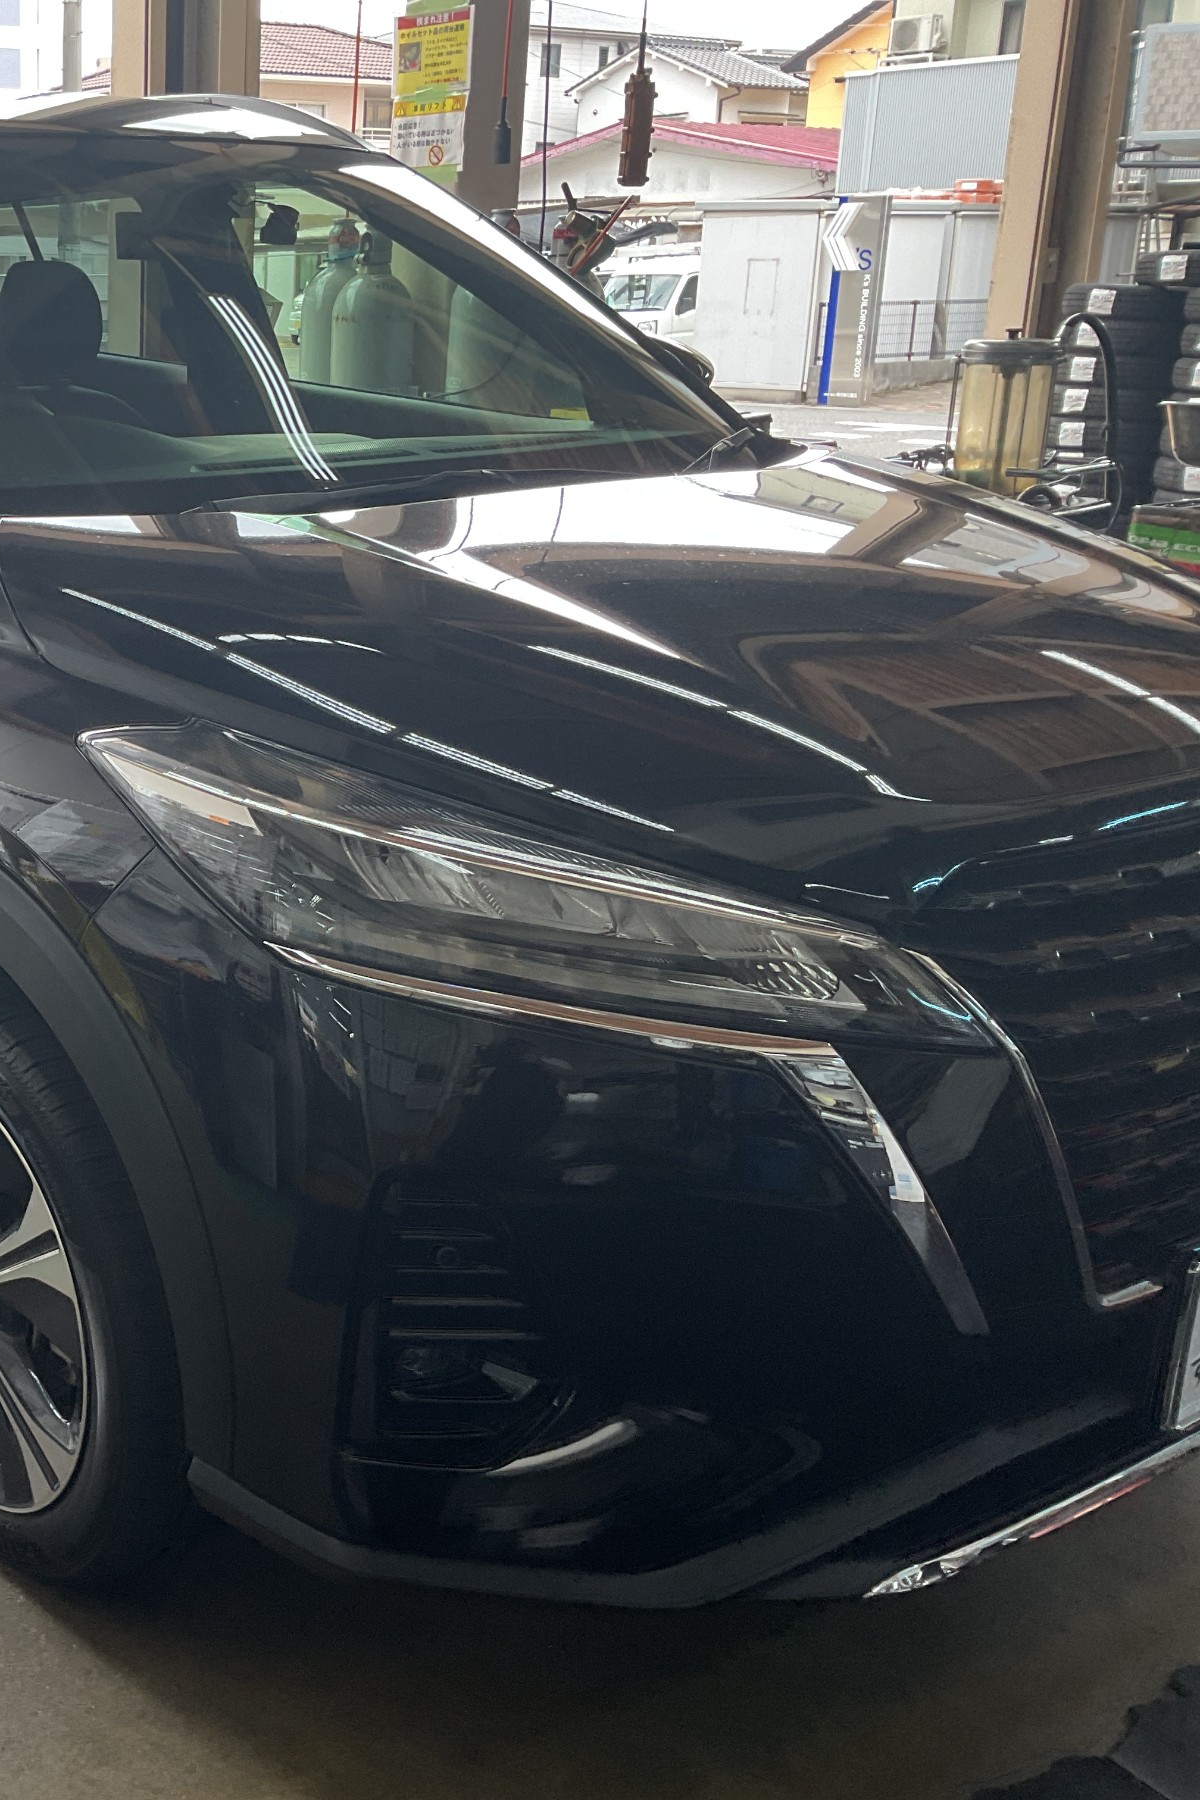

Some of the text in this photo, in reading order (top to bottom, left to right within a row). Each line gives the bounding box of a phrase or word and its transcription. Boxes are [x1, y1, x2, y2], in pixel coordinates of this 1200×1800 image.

[858, 288, 870, 332] BUILDING
[856, 333, 865, 356] since
[853, 357, 862, 378] 2003
